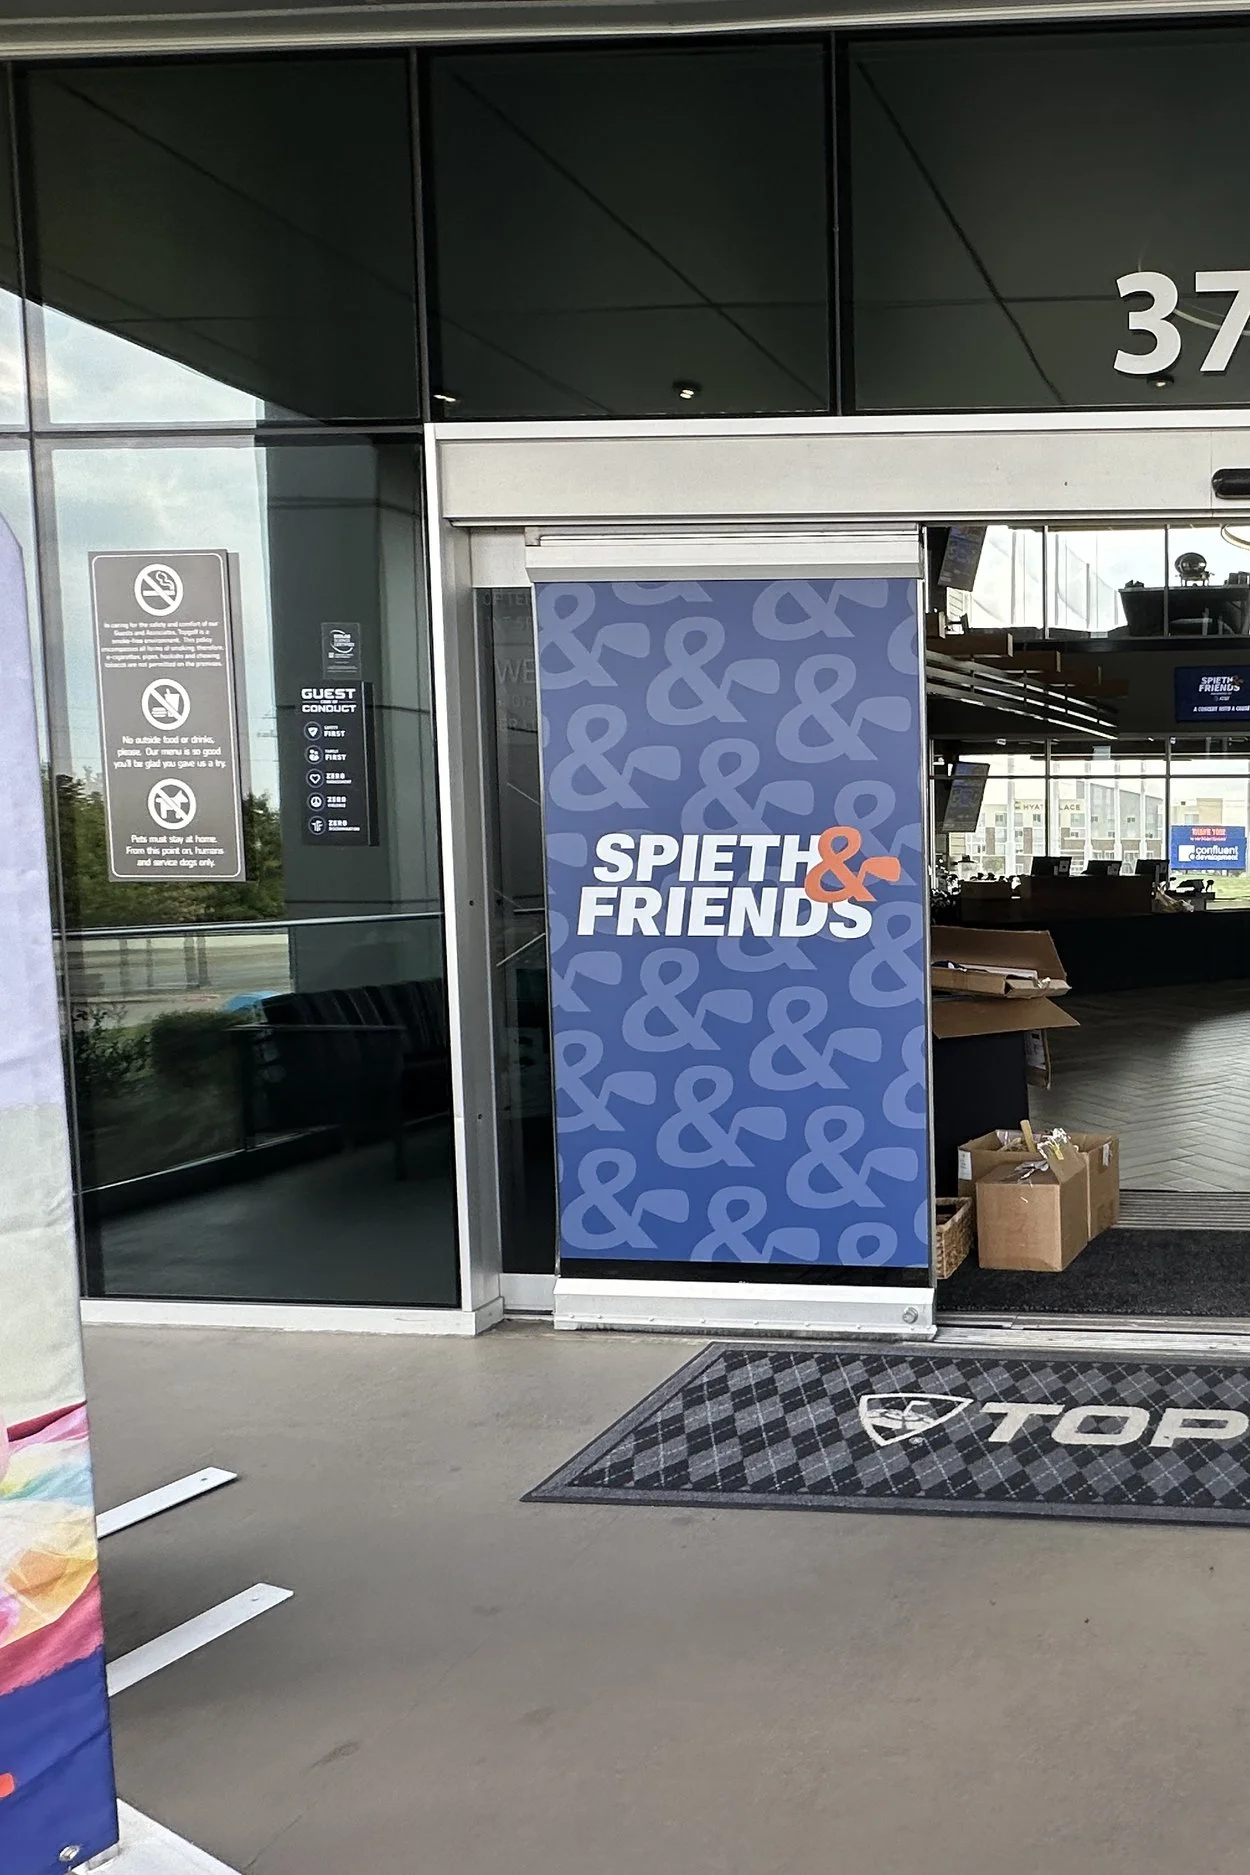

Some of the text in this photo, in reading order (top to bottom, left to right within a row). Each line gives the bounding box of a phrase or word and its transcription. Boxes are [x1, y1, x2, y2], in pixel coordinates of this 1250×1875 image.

[1201, 676, 1234, 685] SPIETH
[1198, 683, 1241, 692] FRIENDS
[301, 688, 356, 699] GUEST
[302, 704, 357, 713] CONDUCT
[122, 736, 134, 744] No
[163, 736, 179, 744] food
[145, 747, 160, 756] Our
[202, 747, 222, 757] good
[144, 759, 161, 769] glad
[162, 760, 176, 769] you
[177, 760, 195, 769] gave
[196, 760, 207, 768] us
[326, 772, 346, 780] ZERO
[1058, 803, 1081, 811] LACE
[131, 834, 147, 843] Pets
[168, 836, 184, 845] stay
[126, 846, 145, 855] From
[146, 846, 160, 855] this
[162, 847, 180, 856] point
[1195, 845, 1239, 855] confluent
[137, 858, 151, 866] and
[179, 858, 197, 869] dogs
[593, 825, 902, 904] SPIETH &
[577, 886, 873, 939] FRIENDS
